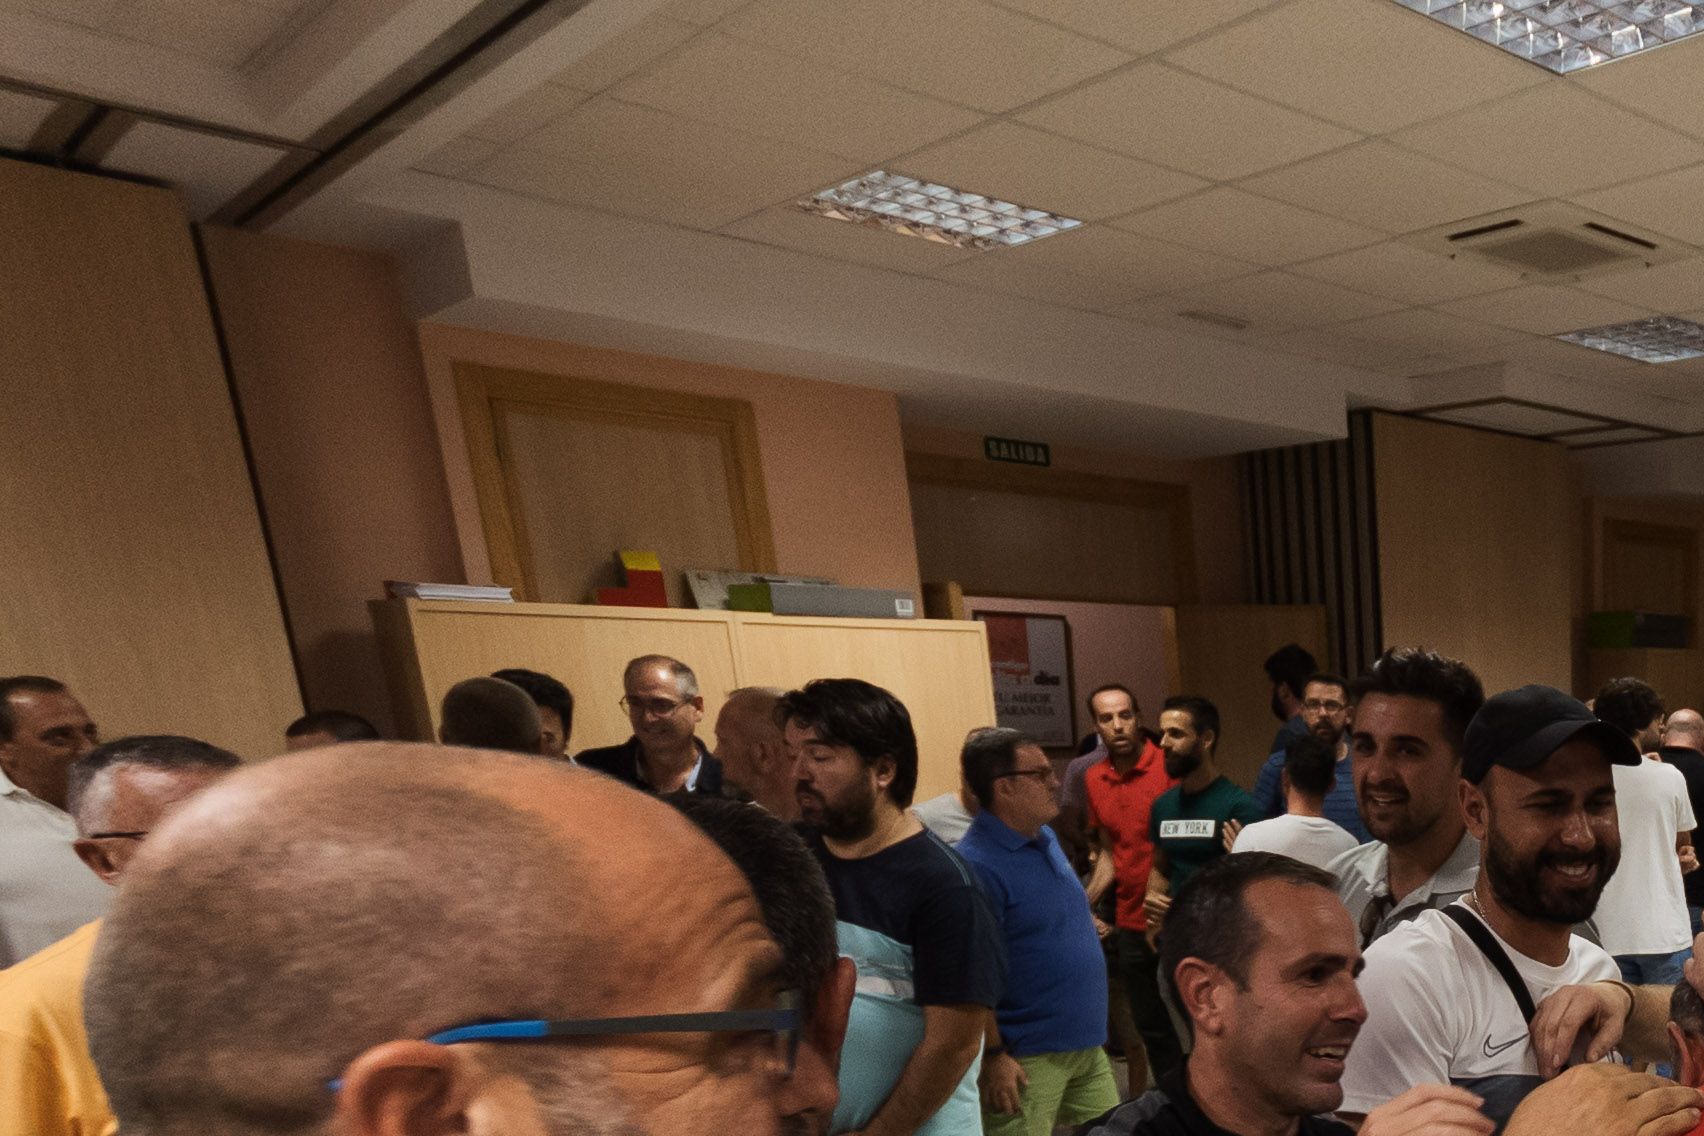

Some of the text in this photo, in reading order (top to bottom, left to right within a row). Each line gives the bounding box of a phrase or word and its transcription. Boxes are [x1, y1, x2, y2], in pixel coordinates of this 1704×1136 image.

[988, 439, 1048, 464] SALIDA
[1163, 821, 1208, 834] NEW YORK
